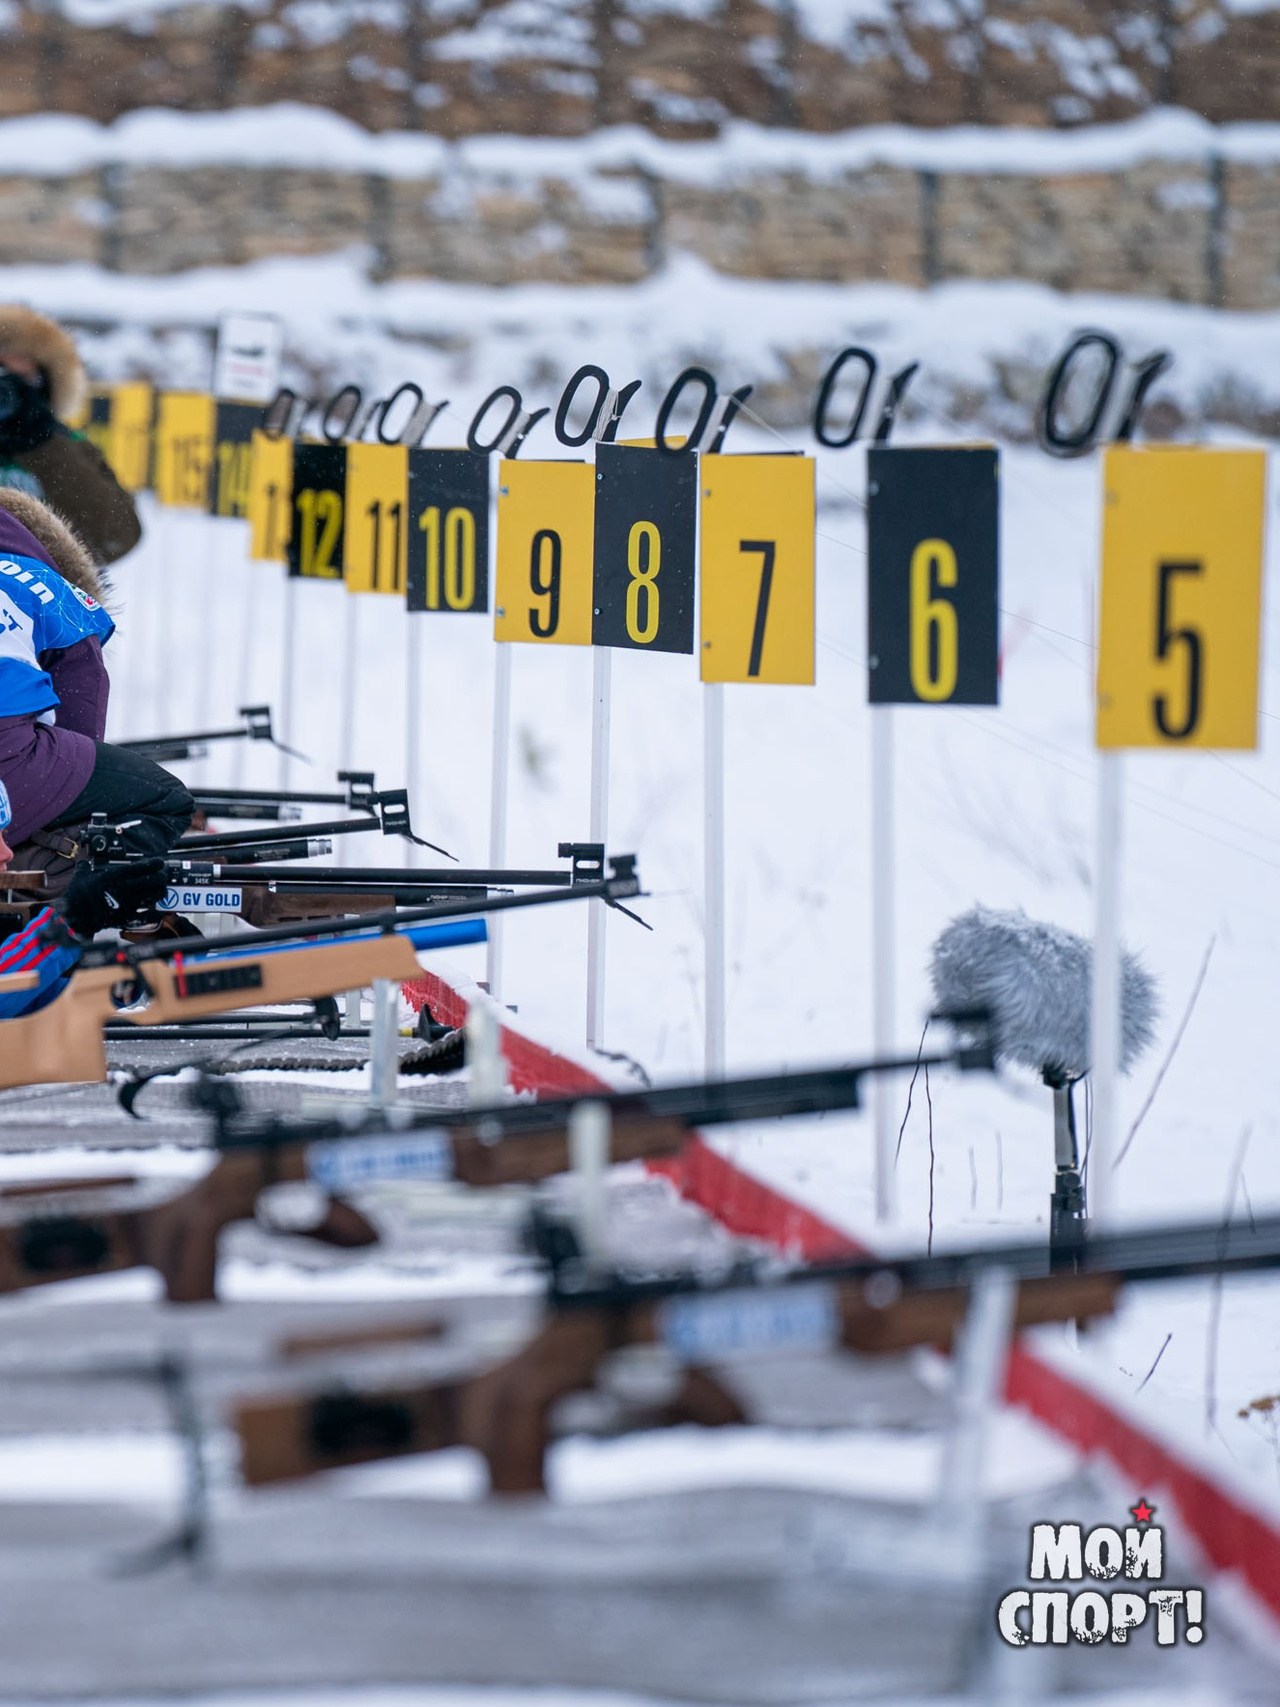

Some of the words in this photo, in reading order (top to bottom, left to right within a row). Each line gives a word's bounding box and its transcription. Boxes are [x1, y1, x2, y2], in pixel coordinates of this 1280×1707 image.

[296, 489, 344, 579] 12
[367, 500, 402, 591] 11
[419, 506, 476, 611] 10
[528, 529, 562, 638] 9
[626, 521, 662, 643] 8
[739, 539, 776, 677] 7
[909, 537, 959, 702] 6
[1152, 557, 1205, 742] 5
[183, 893, 203, 906] GV
[206, 892, 241, 907] GOLD
